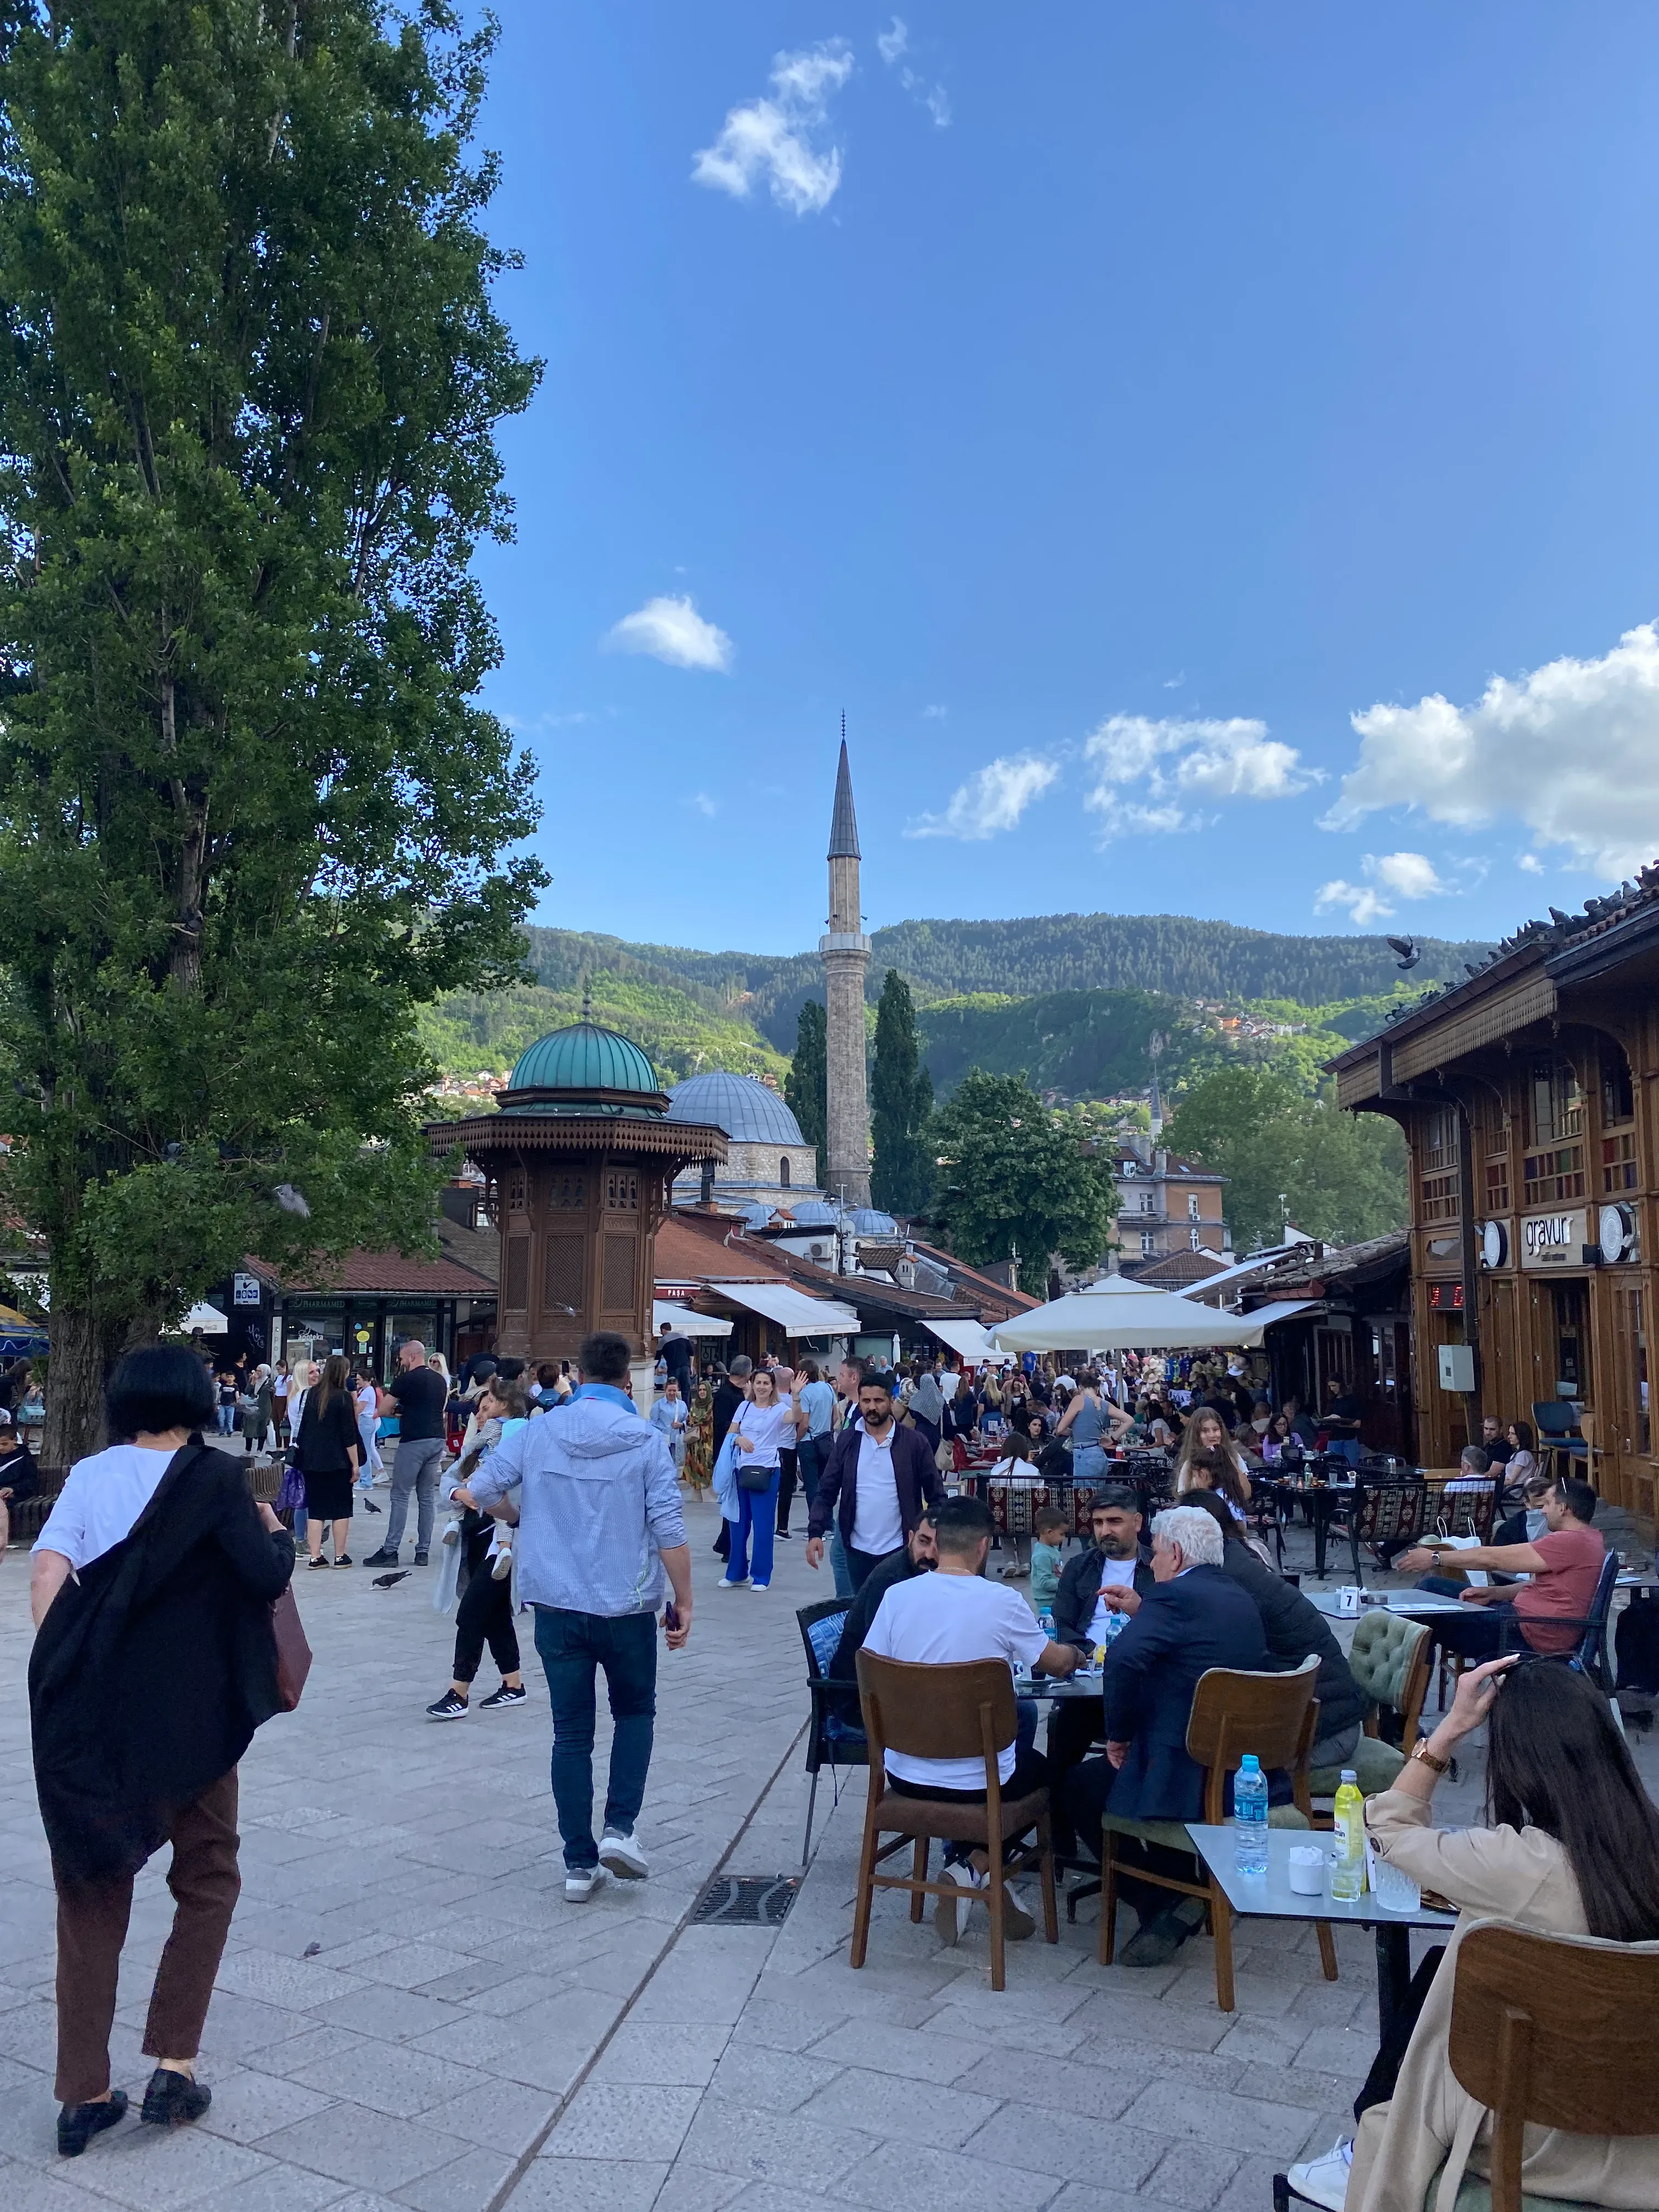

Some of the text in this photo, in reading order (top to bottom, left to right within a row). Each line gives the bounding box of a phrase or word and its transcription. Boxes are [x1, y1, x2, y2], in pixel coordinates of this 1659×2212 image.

[1526, 1217, 1568, 1256] gravur
[303, 1300, 345, 1308] PHARMAMED
[298, 1333, 324, 1341] apoteka
[1347, 1595, 1352, 1606] 7
